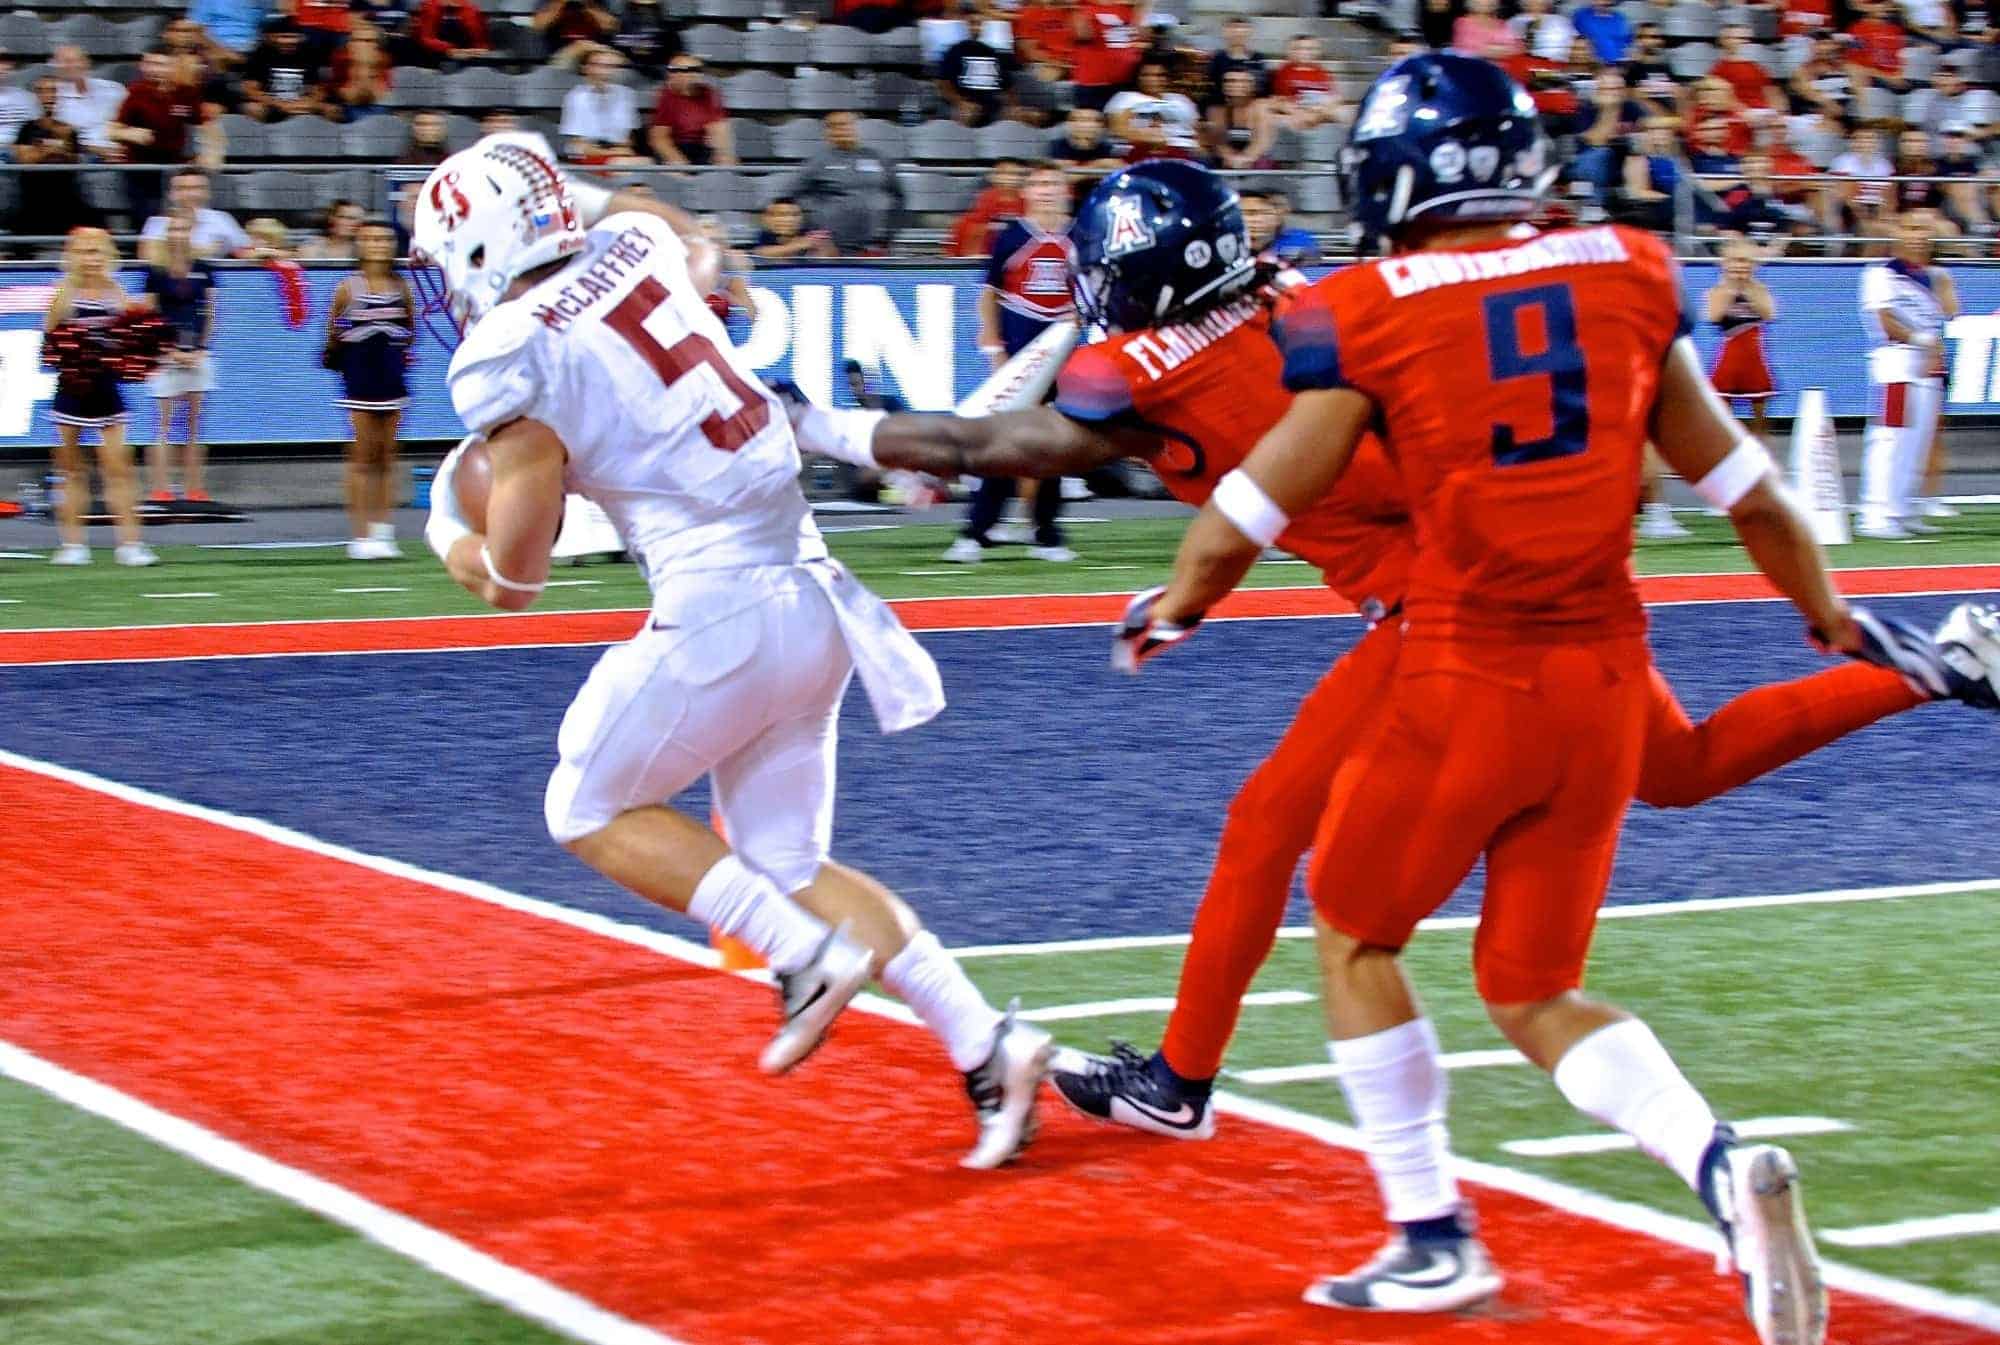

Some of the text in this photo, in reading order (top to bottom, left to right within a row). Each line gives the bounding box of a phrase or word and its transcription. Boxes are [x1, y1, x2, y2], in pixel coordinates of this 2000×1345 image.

[1103, 193, 1157, 257] A
[600, 274, 771, 453] 5
[1483, 282, 1590, 468] 9
